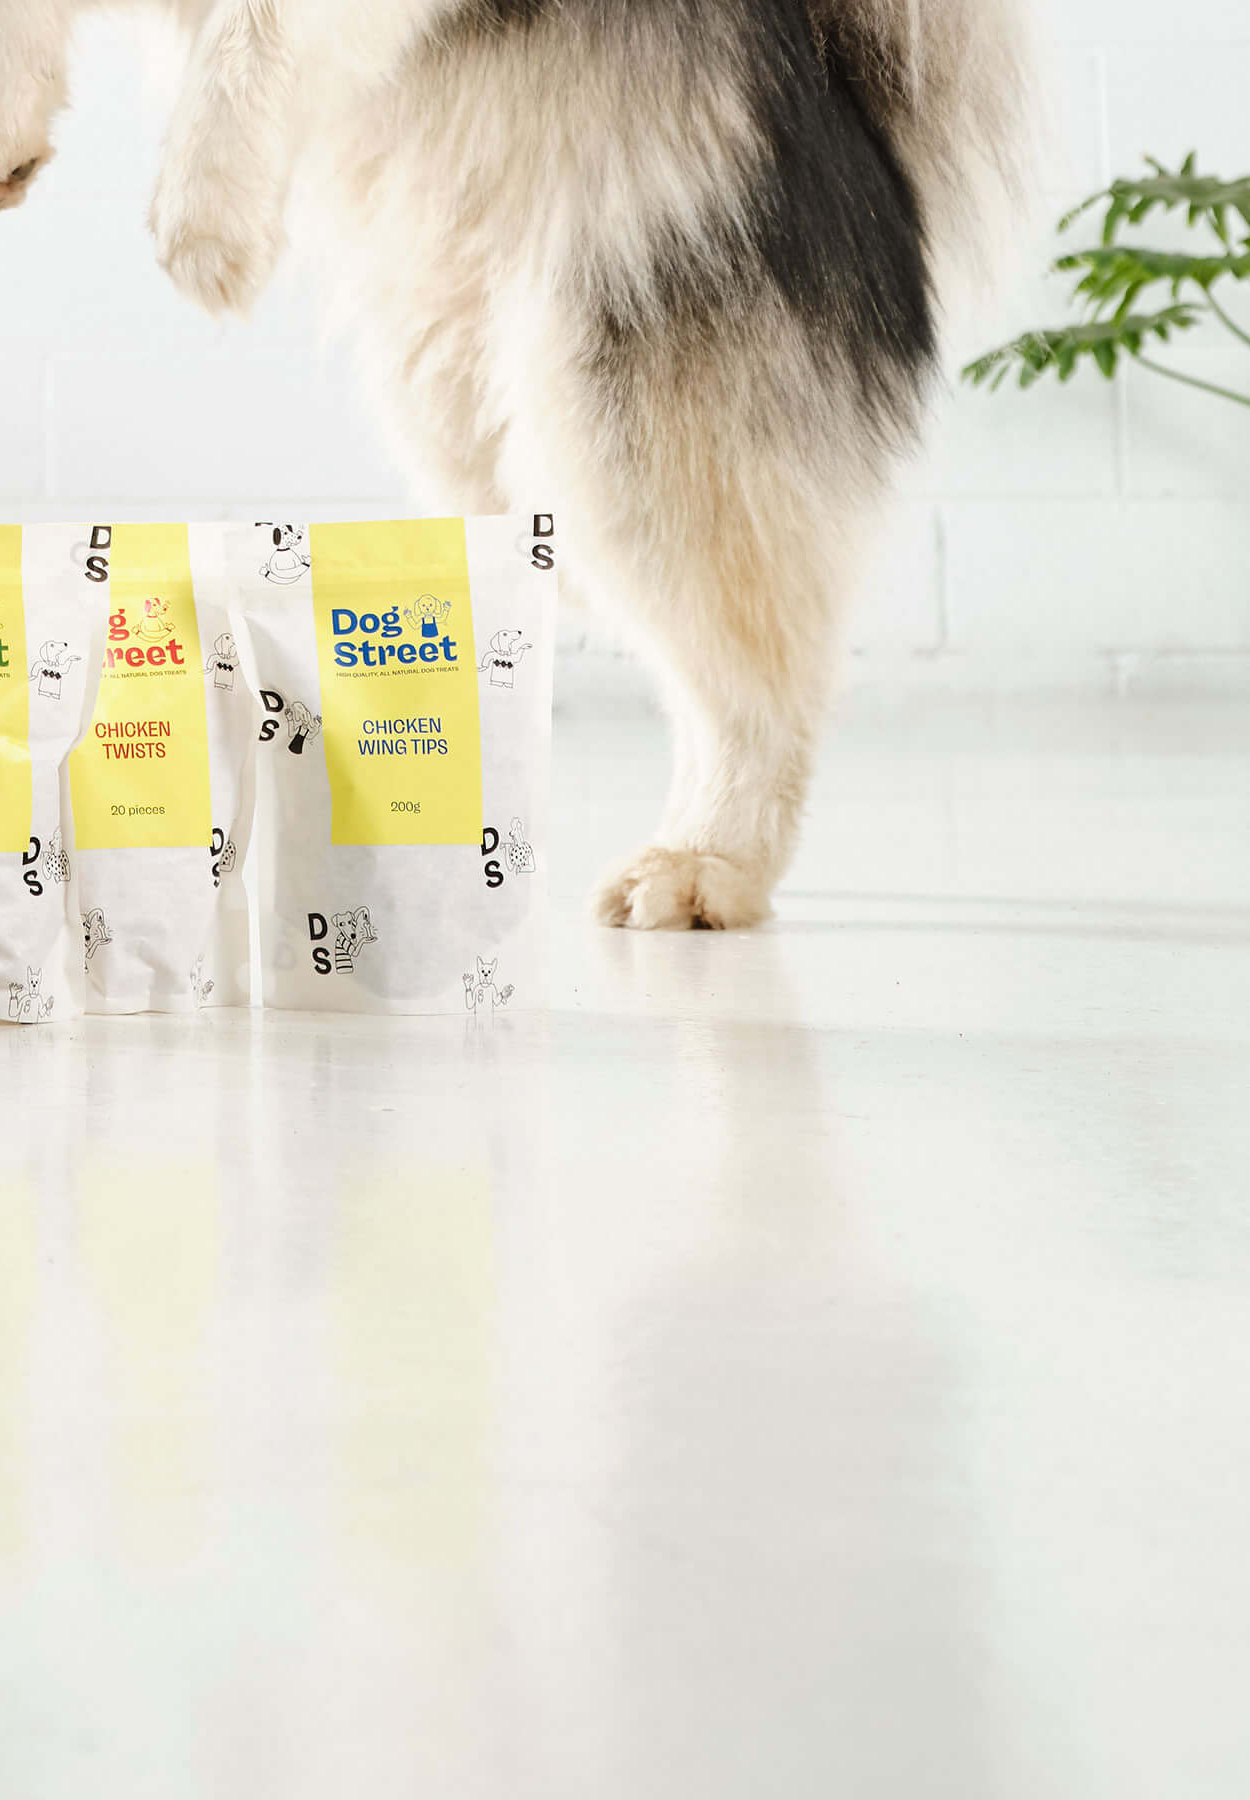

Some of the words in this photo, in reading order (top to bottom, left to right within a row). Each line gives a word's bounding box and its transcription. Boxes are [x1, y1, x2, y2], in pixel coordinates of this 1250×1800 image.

[331, 606, 403, 638] Dog
[102, 638, 185, 668] reet
[333, 635, 458, 668] Street
[94, 720, 171, 739] CHICKEN
[362, 717, 442, 735] CHICKEN
[101, 742, 167, 760] TWISTS
[357, 738, 407, 756] WING
[409, 738, 449, 756] TIPS
[110, 804, 126, 816] 20
[128, 804, 166, 817] pieces
[390, 801, 422, 814] 200g
